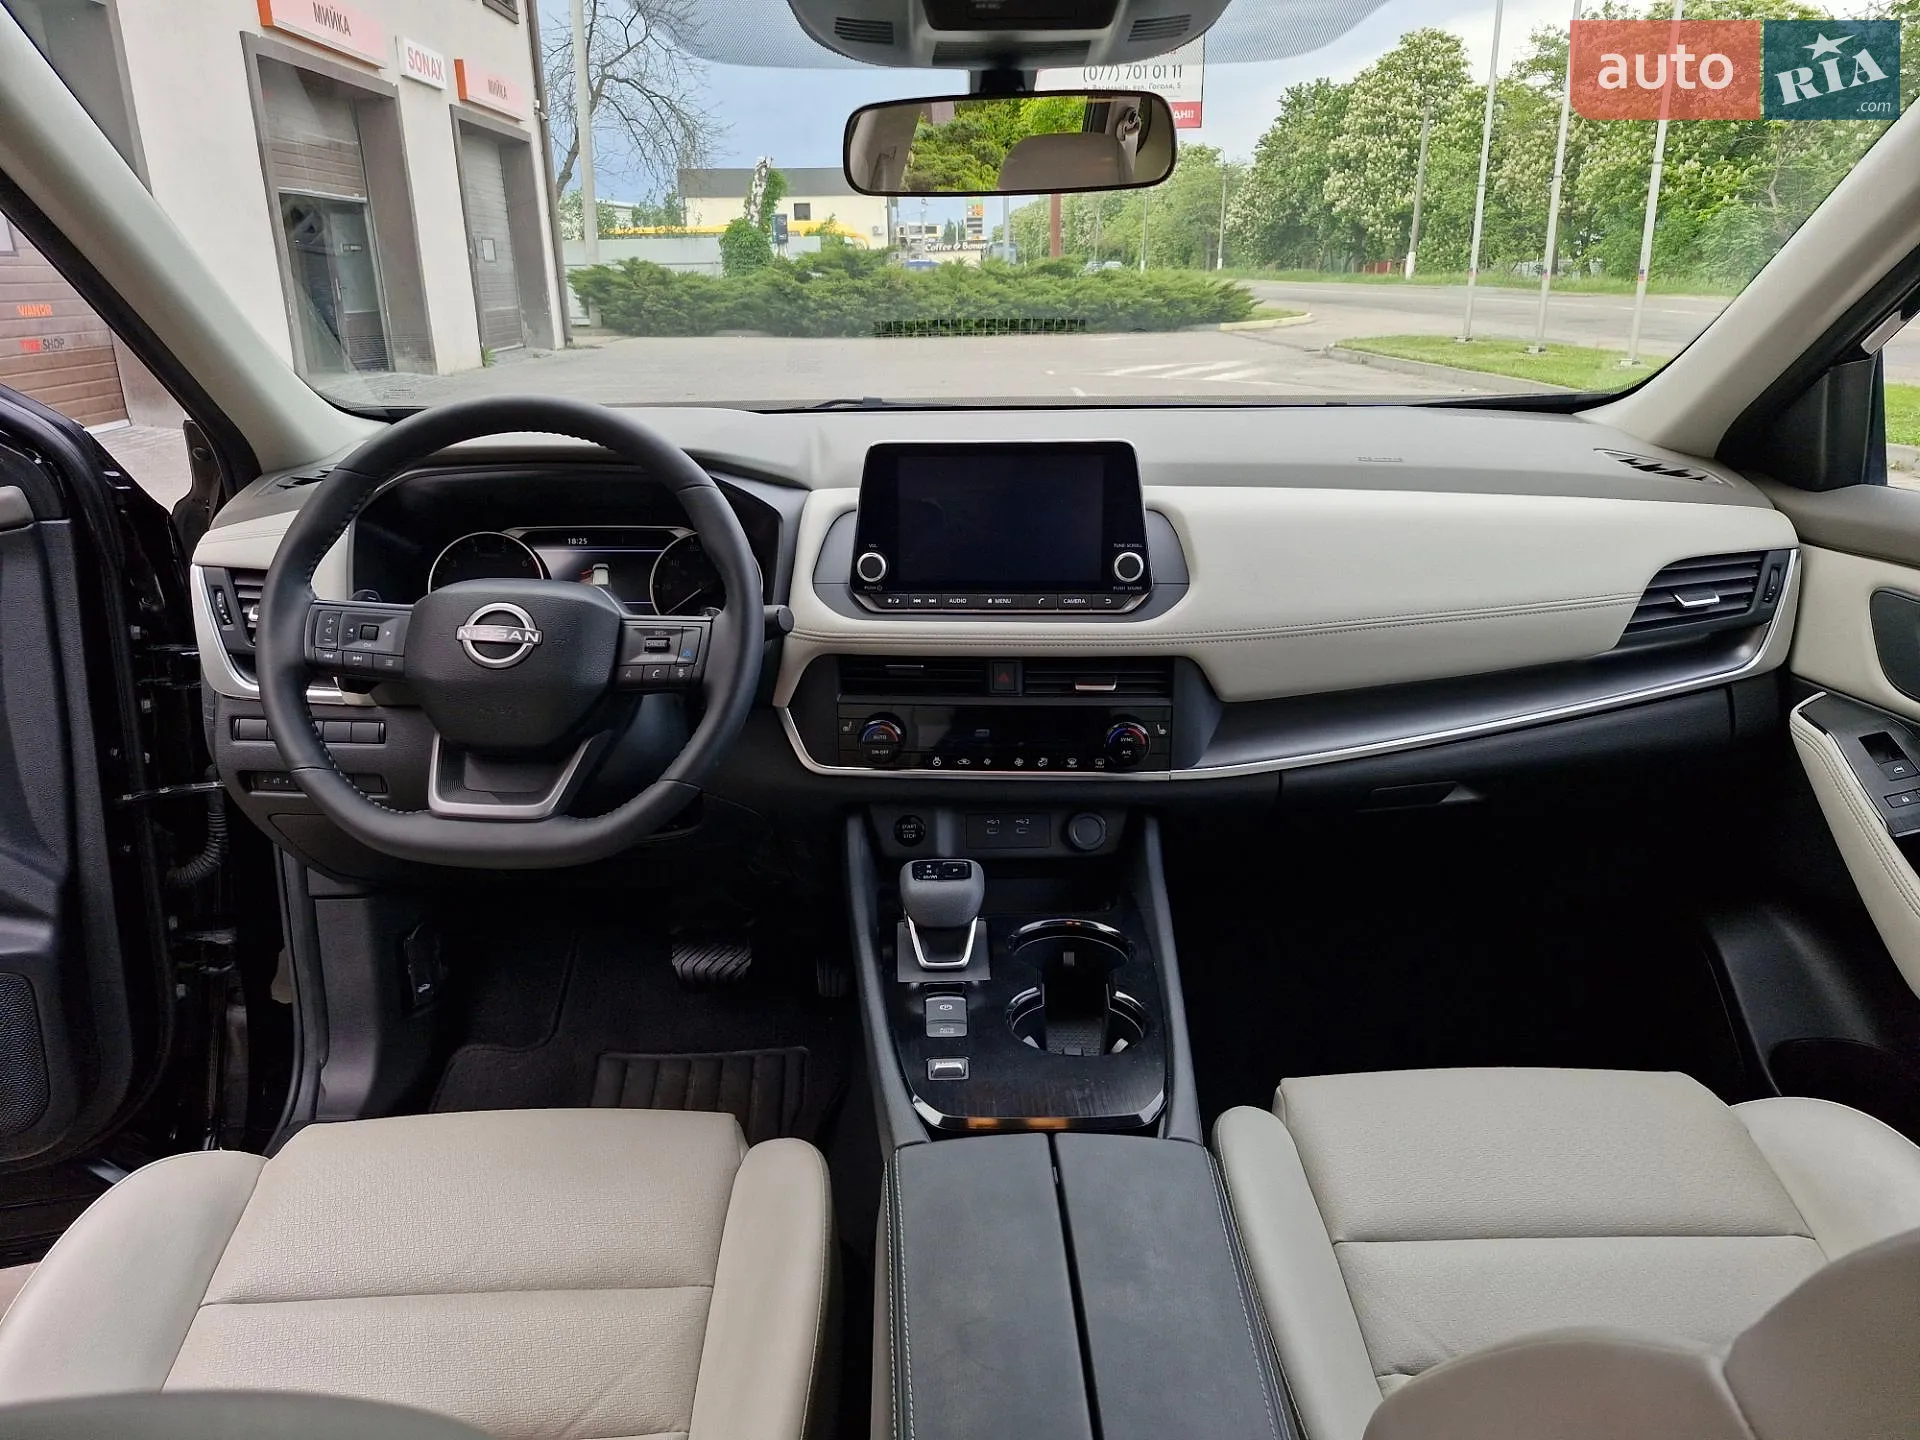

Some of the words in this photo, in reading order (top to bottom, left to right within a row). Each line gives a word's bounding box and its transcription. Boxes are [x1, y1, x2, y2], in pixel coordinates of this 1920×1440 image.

[312, 2, 352, 37] МИЙКА
[407, 46, 444, 83] SONAX
[1083, 64, 1120, 82] (077)
[1125, 64, 1147, 80] 701
[1152, 63, 1167, 79] 01
[1172, 63, 1183, 79] 11
[487, 79, 508, 99] МИЙКА
[925, 243, 952, 253] Coffee
[42, 338, 65, 352] SHOP
[567, 537, 588, 545] 18:25
[459, 629, 540, 643] NISSAN
